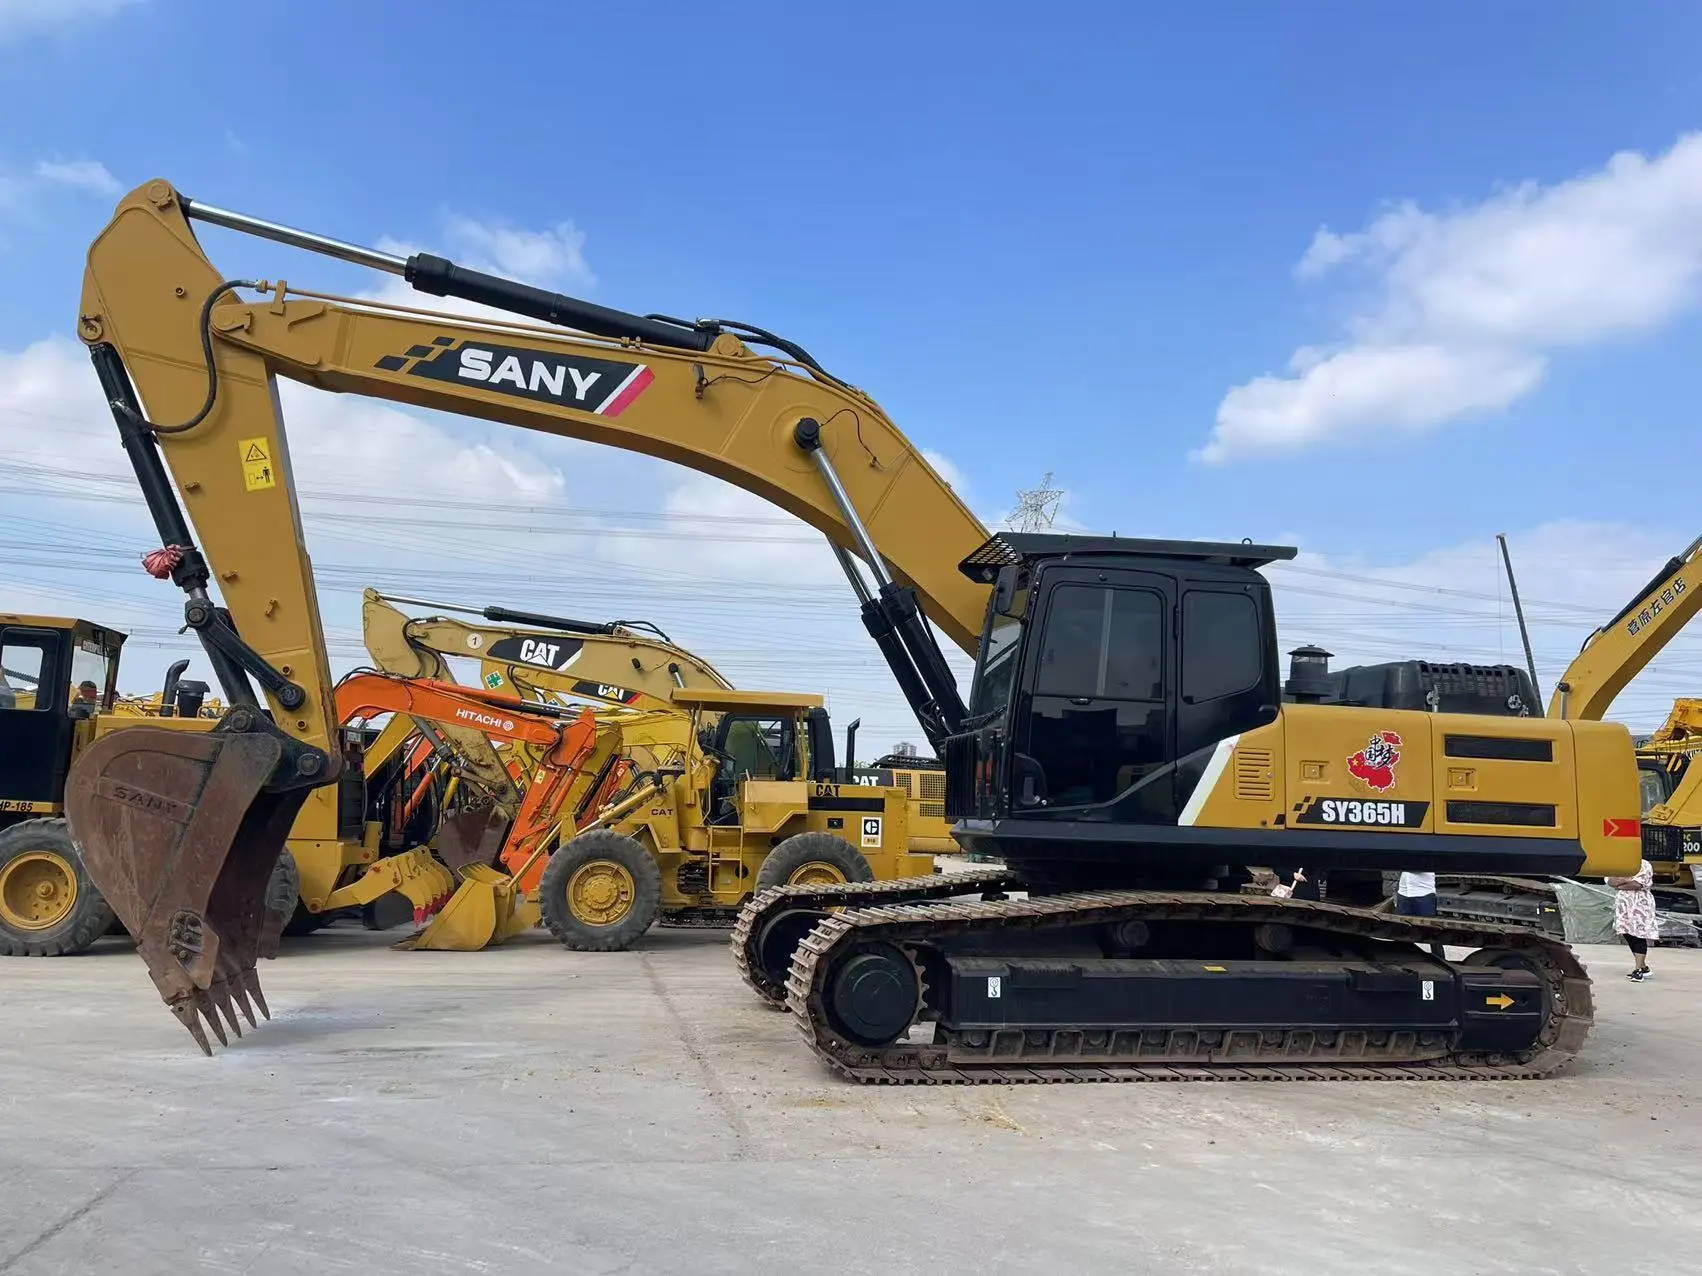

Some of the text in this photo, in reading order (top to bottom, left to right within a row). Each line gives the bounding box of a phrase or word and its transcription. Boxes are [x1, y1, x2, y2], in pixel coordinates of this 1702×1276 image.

[458, 348, 602, 401] SANY
[472, 636, 478, 646] 1
[520, 639, 560, 667] CAT
[456, 708, 502, 728] HITACHI
[815, 784, 841, 798] CAT
[651, 808, 674, 816] CAT
[1322, 800, 1405, 825] SY365H
